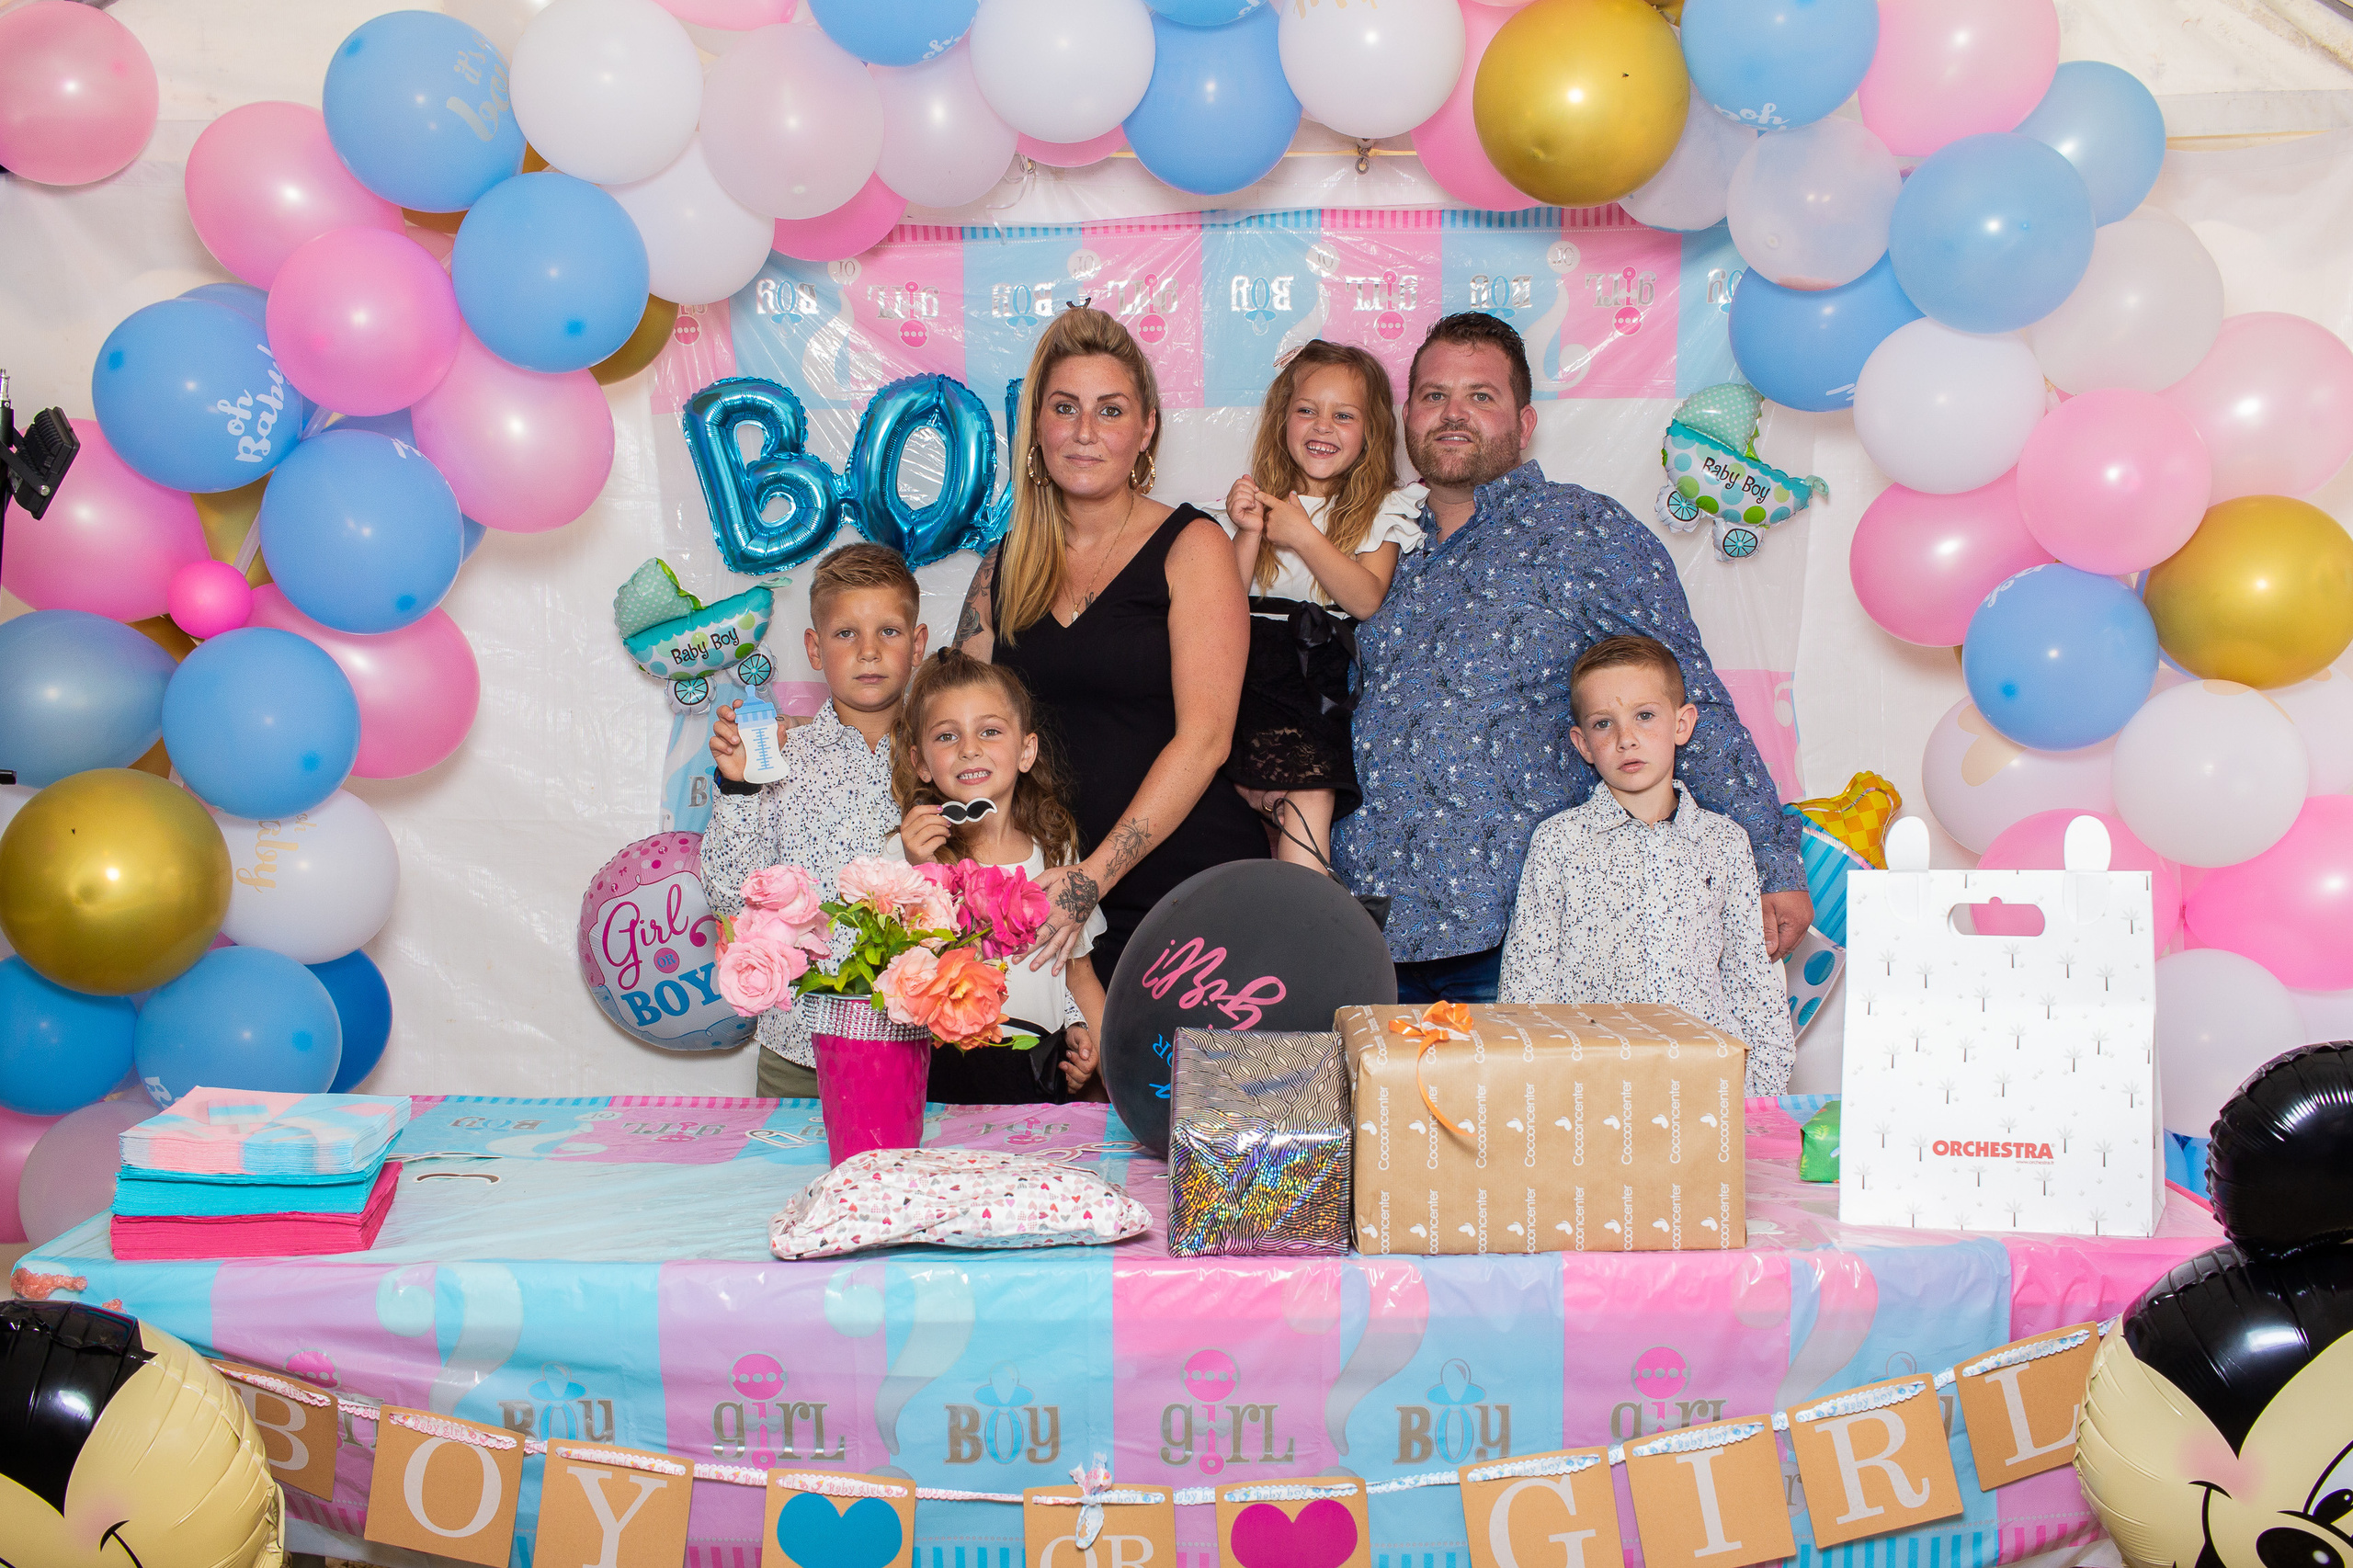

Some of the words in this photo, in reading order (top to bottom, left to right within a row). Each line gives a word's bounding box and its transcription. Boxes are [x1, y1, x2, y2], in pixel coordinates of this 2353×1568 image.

[217, 389, 254, 437] oh
[1700, 456, 1741, 490] Baby
[1741, 474, 1771, 505] Boy
[670, 641, 710, 665] Baby
[710, 627, 741, 651] Boy
[235, 820, 299, 893] aby
[602, 883, 689, 991] Girl
[656, 953, 677, 969] OR
[620, 961, 722, 1027] BOY
[1378, 1085, 1390, 1171] Cocooncenter
[1427, 1085, 1438, 1170] Cocooncter
[1476, 1083, 1487, 1169] Cocooncenter
[1524, 1082, 1536, 1168] Cocooncenter
[1573, 1081, 1584, 1166] Cocooncenter
[1620, 1079, 1632, 1165] Cocooncenter
[1669, 1078, 1681, 1165] Cocooncenter
[1718, 1077, 1730, 1164] Cocooncenter
[1932, 1140, 2054, 1159] ORCHESTRA
[1379, 1189, 1391, 1255] cooncenter
[1427, 1188, 1439, 1255] cooncenter
[1475, 1187, 1488, 1254] cooncenter
[1524, 1187, 1536, 1254] cooncenter
[1573, 1185, 1585, 1252] cooncenter
[1621, 1184, 1633, 1251] cooncenter
[1670, 1183, 1681, 1250] cooncenter
[1718, 1182, 1730, 1250] cooncenter
[411, 1417, 439, 1434] Baby
[442, 1424, 465, 1438] girl
[826, 1478, 855, 1494] Baby
[858, 1483, 881, 1498] girl
